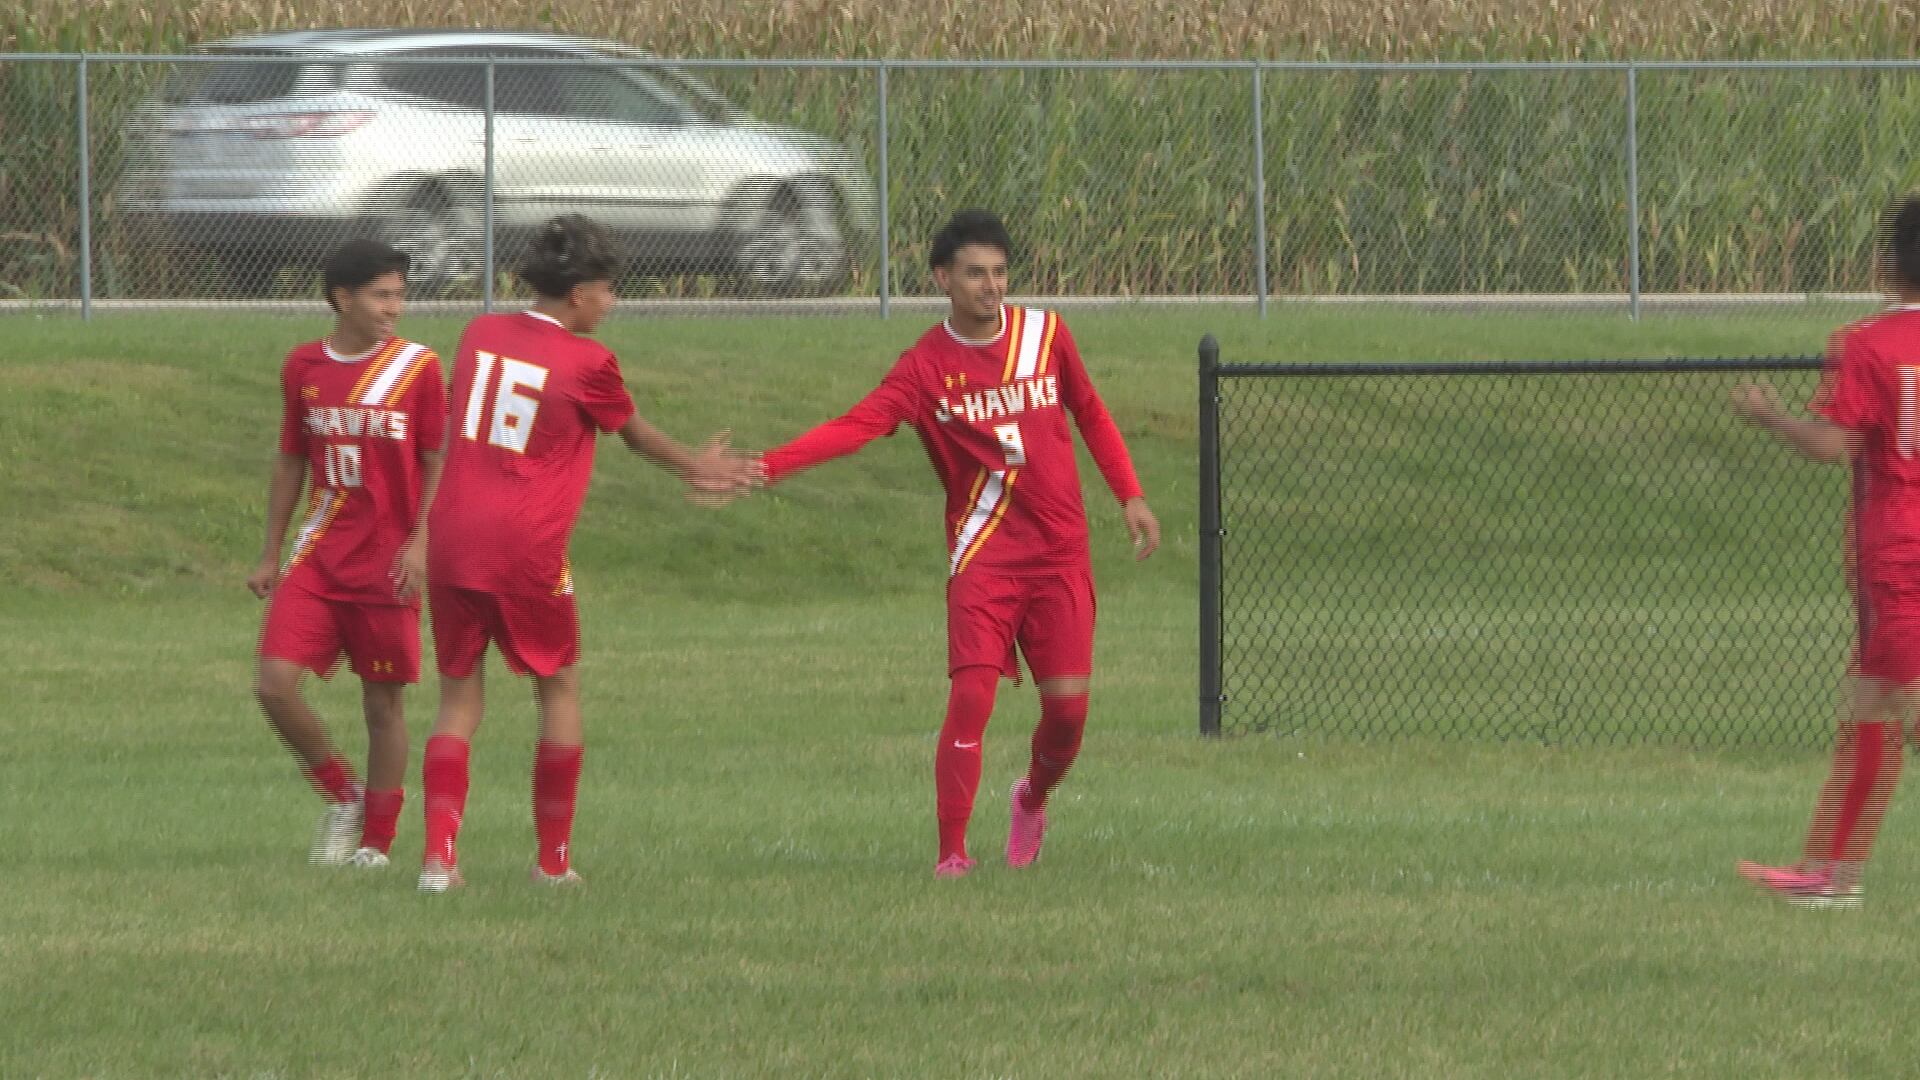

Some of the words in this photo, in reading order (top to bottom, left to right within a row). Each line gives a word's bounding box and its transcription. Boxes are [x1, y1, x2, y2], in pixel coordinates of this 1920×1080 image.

[461, 350, 550, 454] 16
[936, 375, 1058, 423] J-HAWKS
[324, 444, 363, 487] 10
[993, 421, 1026, 465] 9
